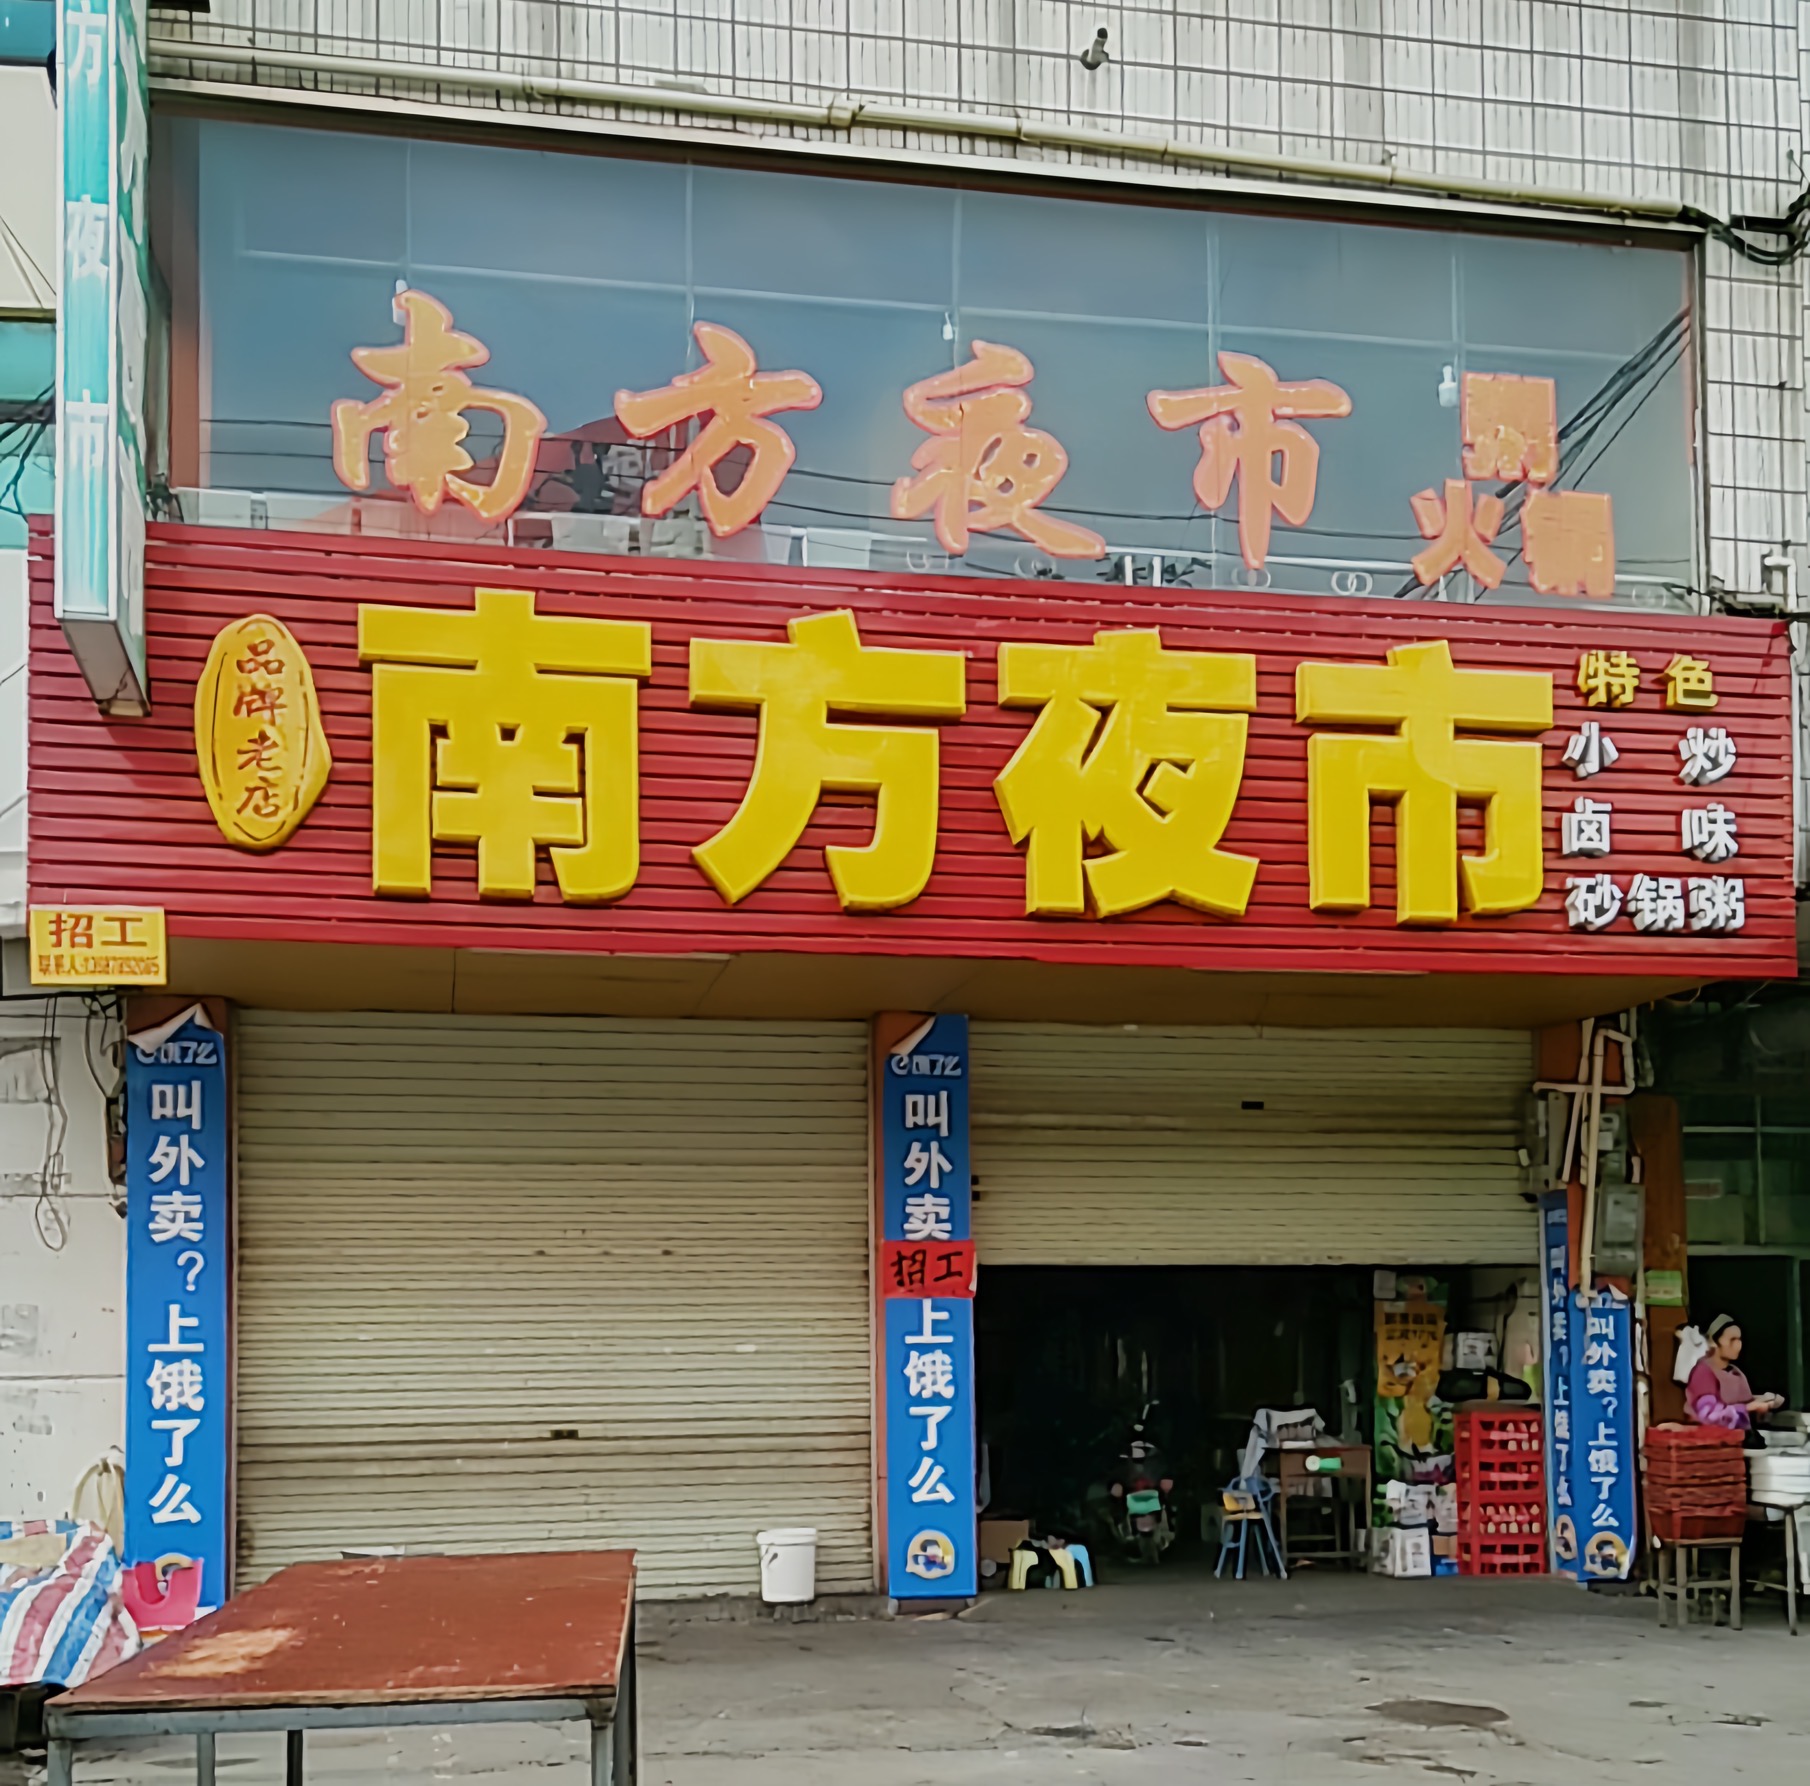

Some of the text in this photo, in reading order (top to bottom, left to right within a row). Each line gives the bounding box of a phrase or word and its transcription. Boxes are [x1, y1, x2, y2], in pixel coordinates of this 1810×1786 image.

[332, 288, 1352, 570] 南方夜市
[1576, 649, 1720, 711] 特色
[232, 638, 288, 819] 品牌老店
[357, 587, 1555, 926] 南方夜市
[1561, 720, 1738, 785] 小炒
[1561, 795, 1740, 862] 卤味
[48, 912, 148, 949] 招工
[1564, 872, 1747, 932] 砂锅粥
[890, 1249, 964, 1288] 招工
